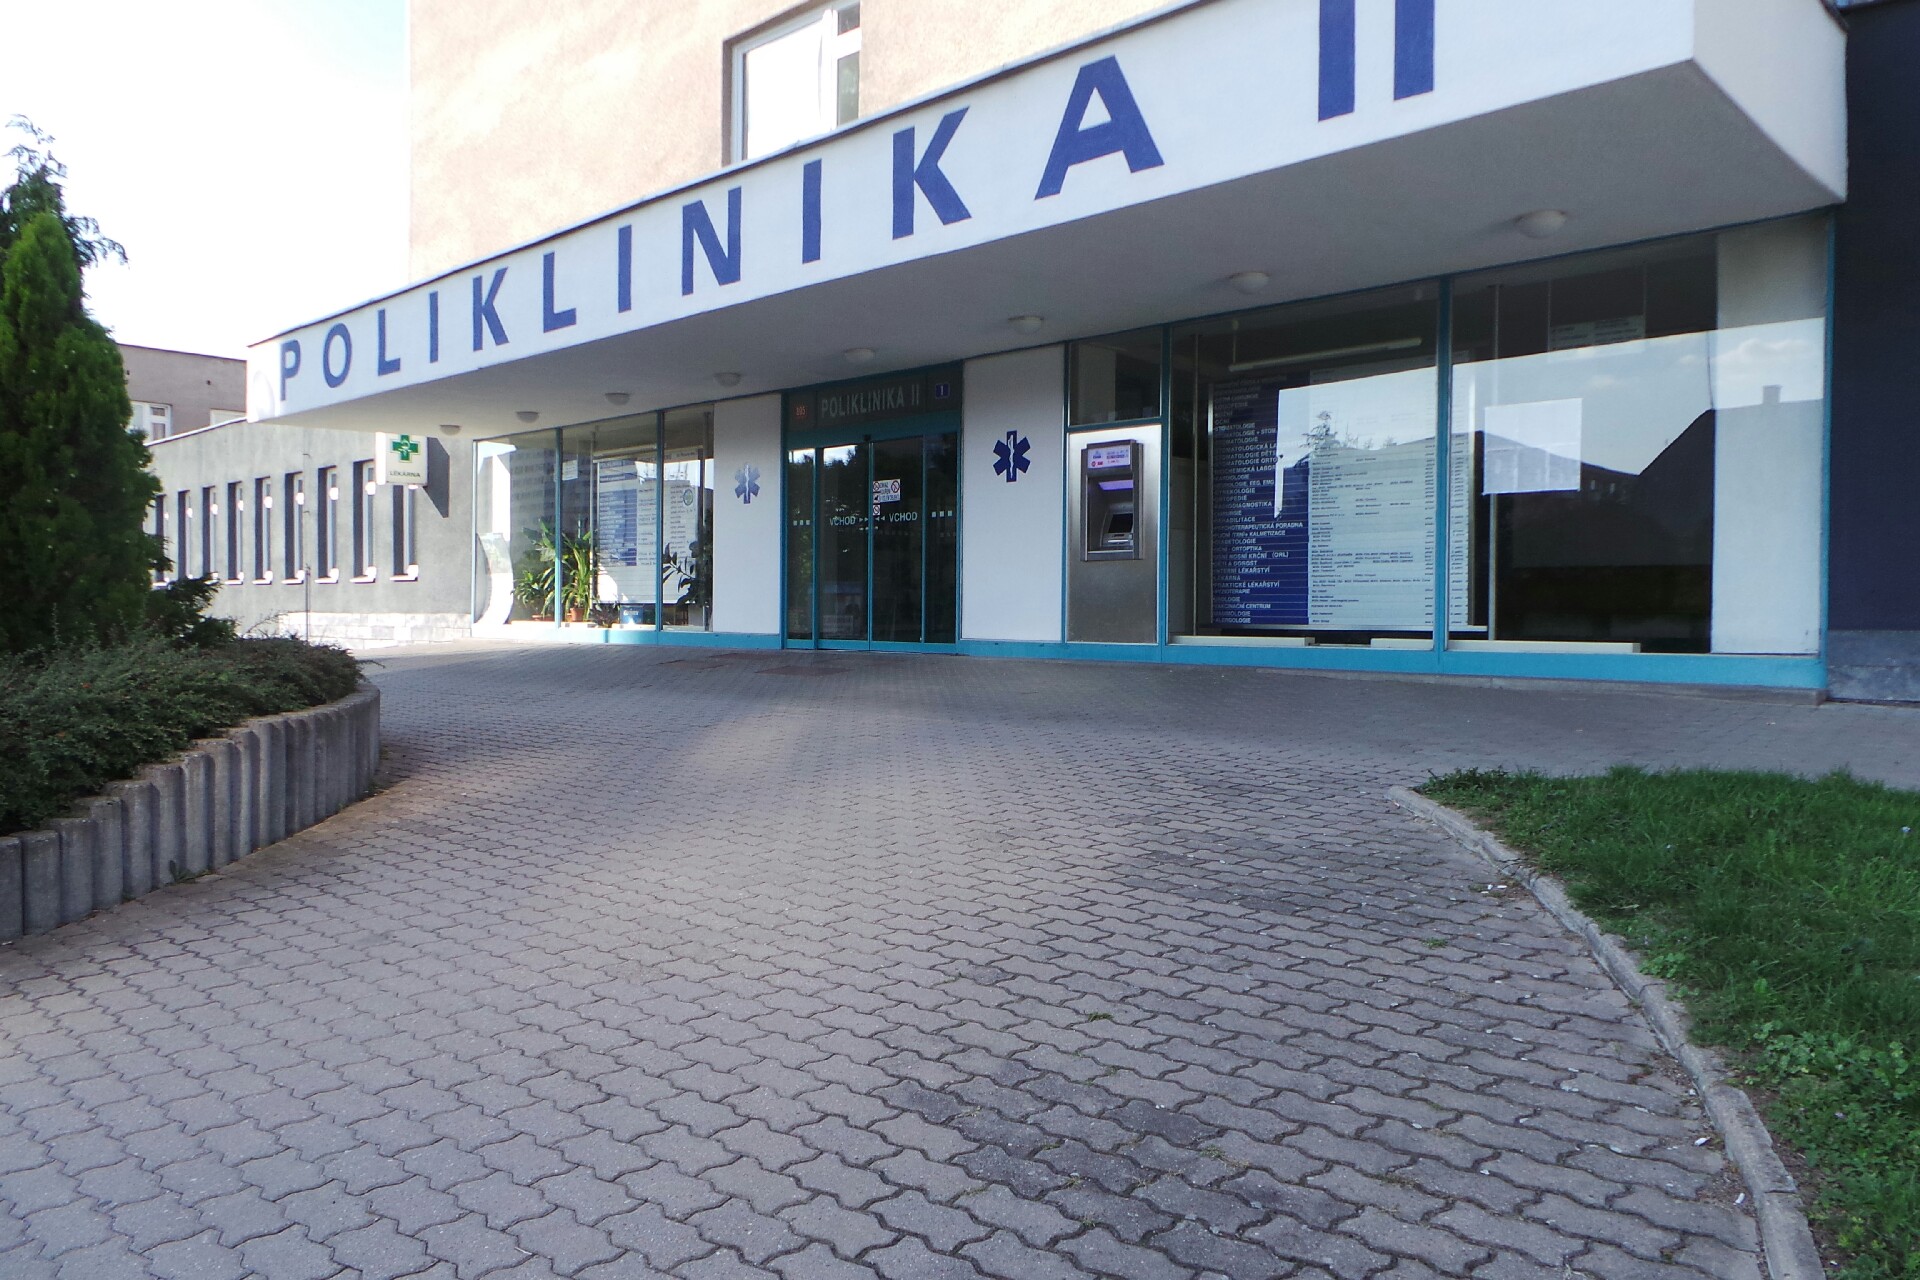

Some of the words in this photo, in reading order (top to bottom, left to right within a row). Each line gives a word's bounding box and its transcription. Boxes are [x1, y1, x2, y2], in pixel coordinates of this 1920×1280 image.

[280, 55, 1164, 401] POLIKLINIKA
[1318, 0, 1434, 122] II
[821, 387, 905, 419] POLIKLINIKA
[911, 384, 920, 406] II
[829, 516, 856, 526] VCHOD
[889, 512, 918, 522] VCHOD
